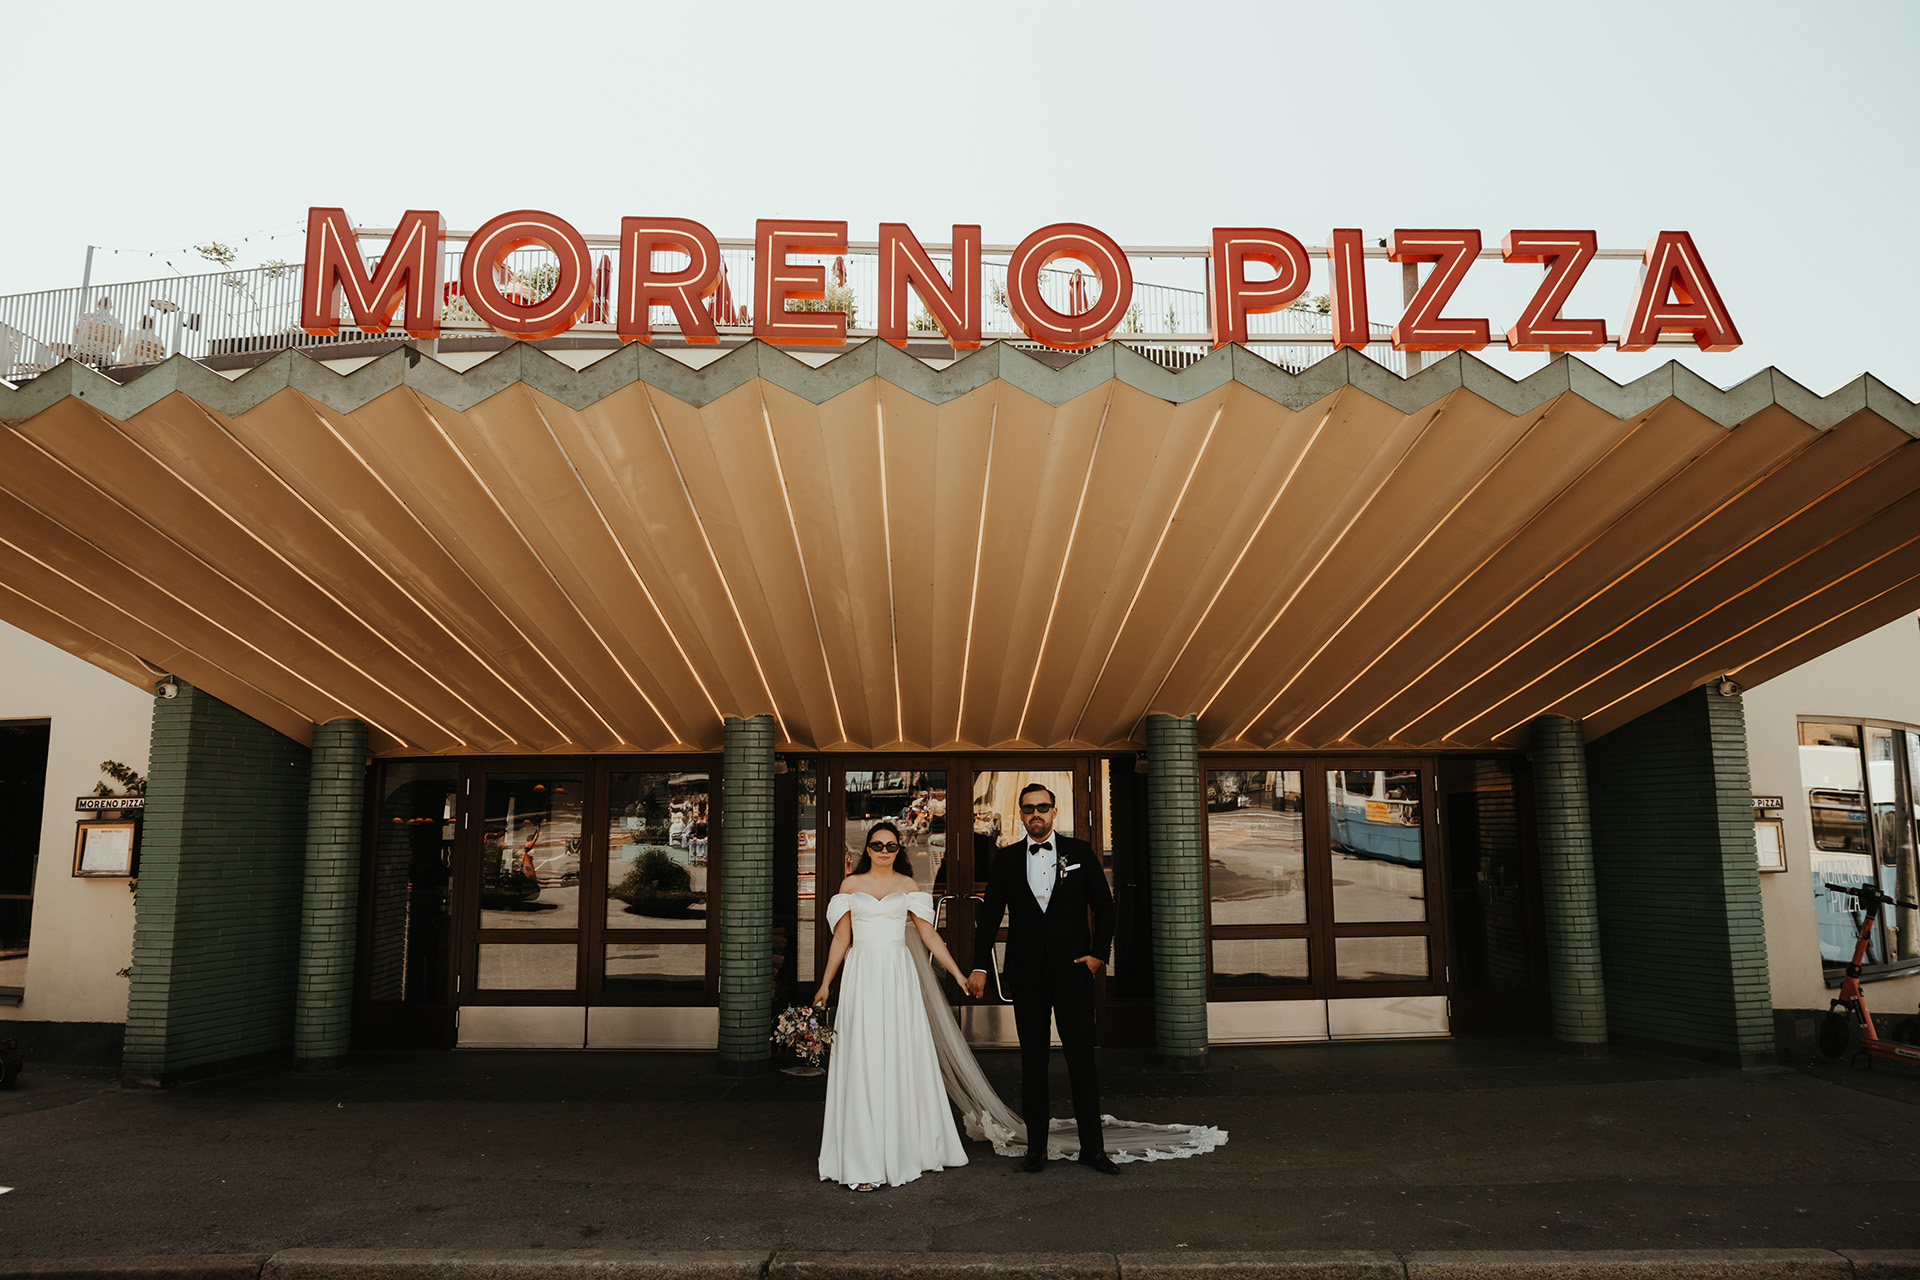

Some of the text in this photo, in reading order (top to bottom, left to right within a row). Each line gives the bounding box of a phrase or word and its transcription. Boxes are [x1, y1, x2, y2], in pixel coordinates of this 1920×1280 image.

[301, 206, 1743, 352] MORENO PIZZA
[79, 799, 144, 808] MORENO PIZZA
[1758, 799, 1781, 807] PIZZA
[1830, 890, 1862, 913] PIZZA
